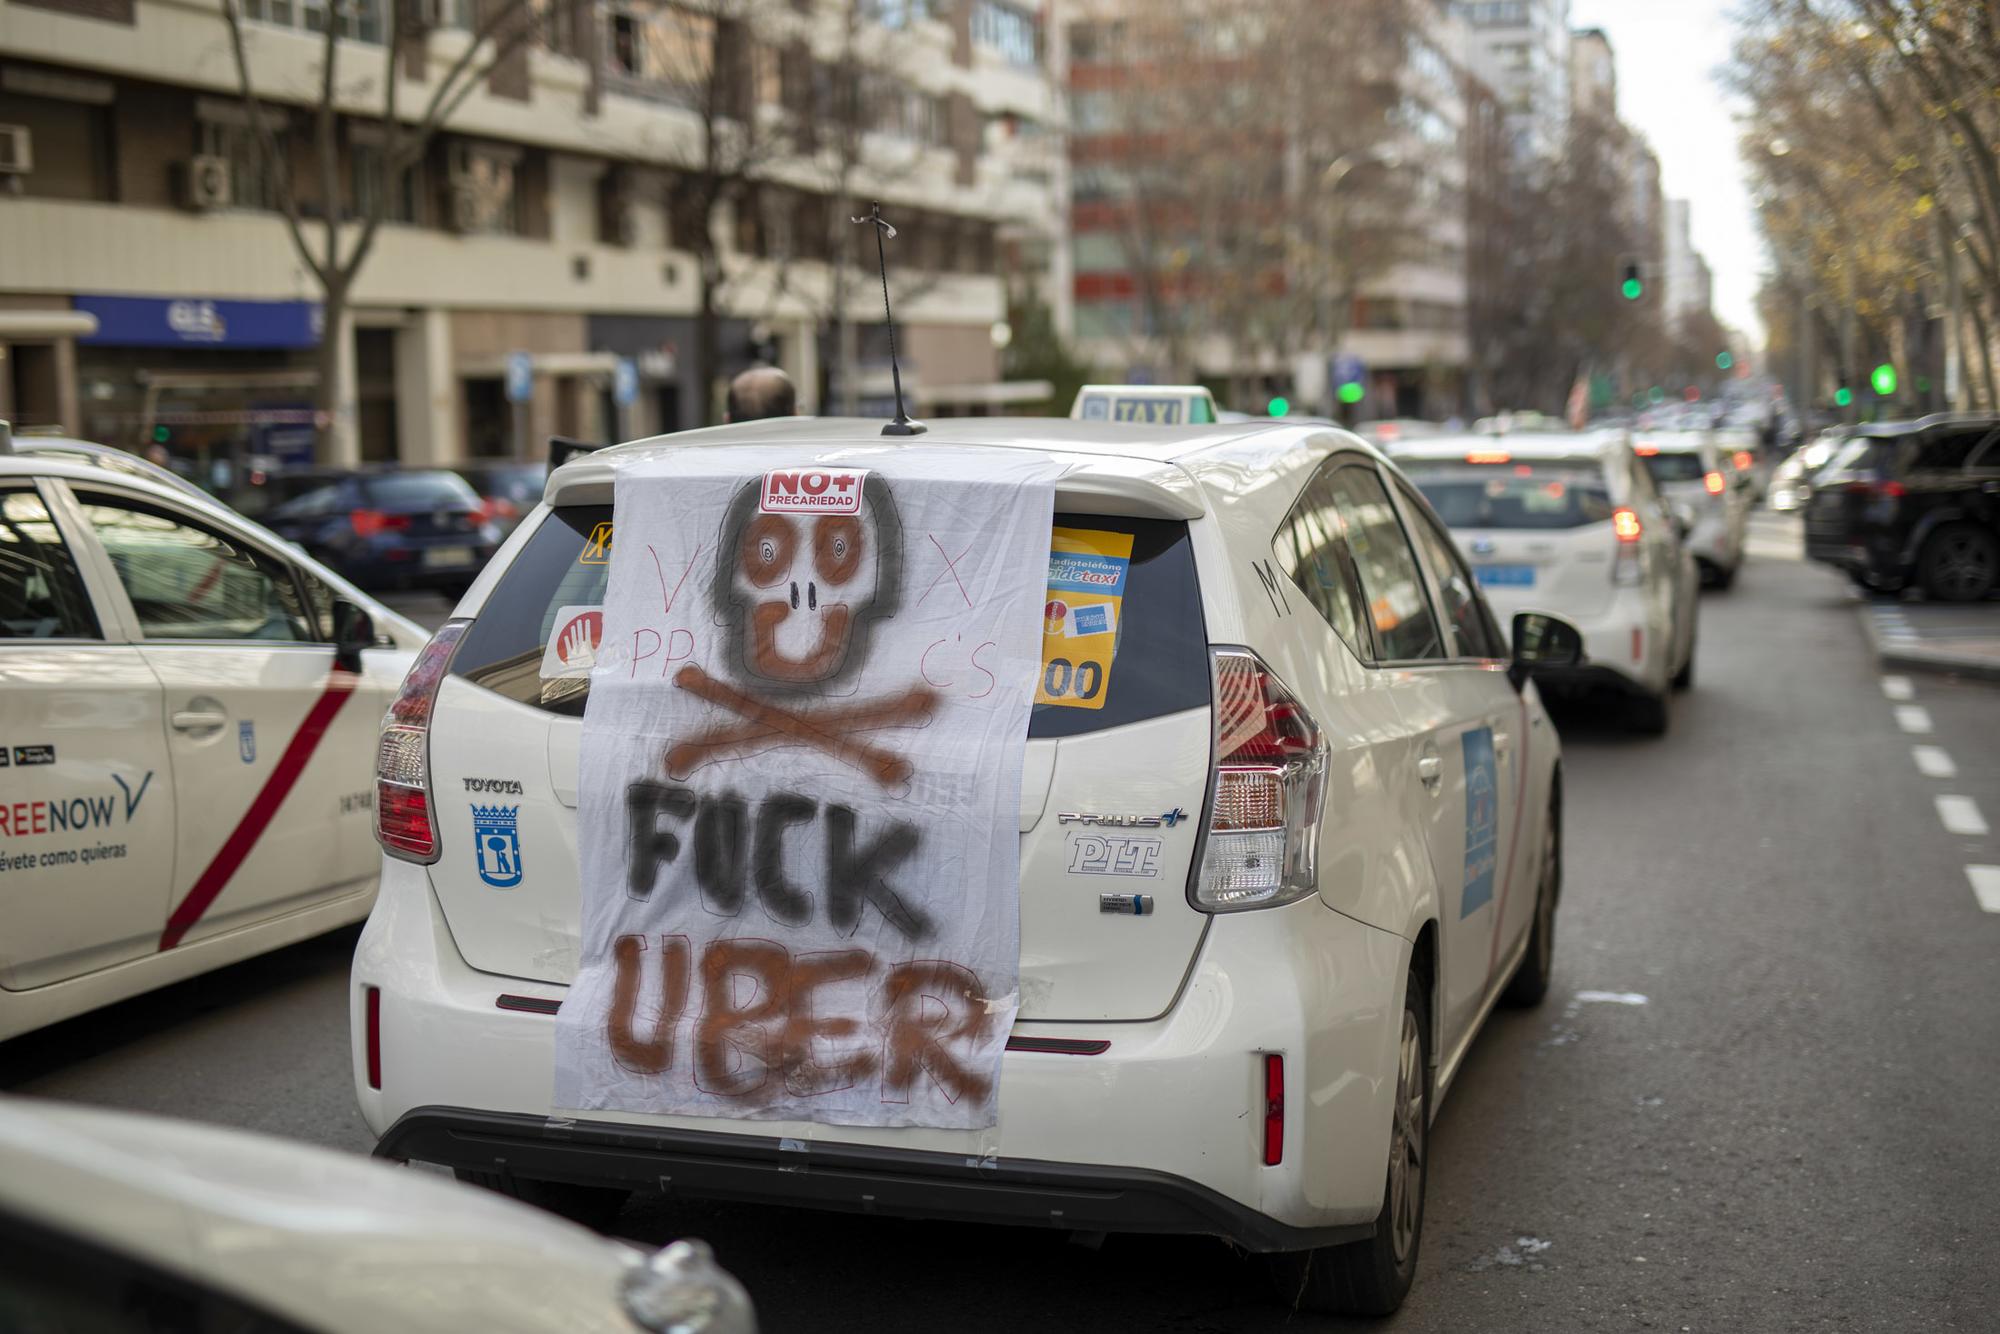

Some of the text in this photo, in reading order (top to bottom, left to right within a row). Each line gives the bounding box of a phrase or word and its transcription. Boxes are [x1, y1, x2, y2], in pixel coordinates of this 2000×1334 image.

[1118, 402, 1181, 424] TAXI
[768, 495, 854, 506] PRECARIEDAD
[632, 628, 695, 678] PP
[462, 778, 523, 795] TOYOTA
[40, 849, 77, 867] como
[81, 842, 126, 865] quieras
[626, 780, 936, 941] FUCK
[608, 934, 994, 1106] UBER
